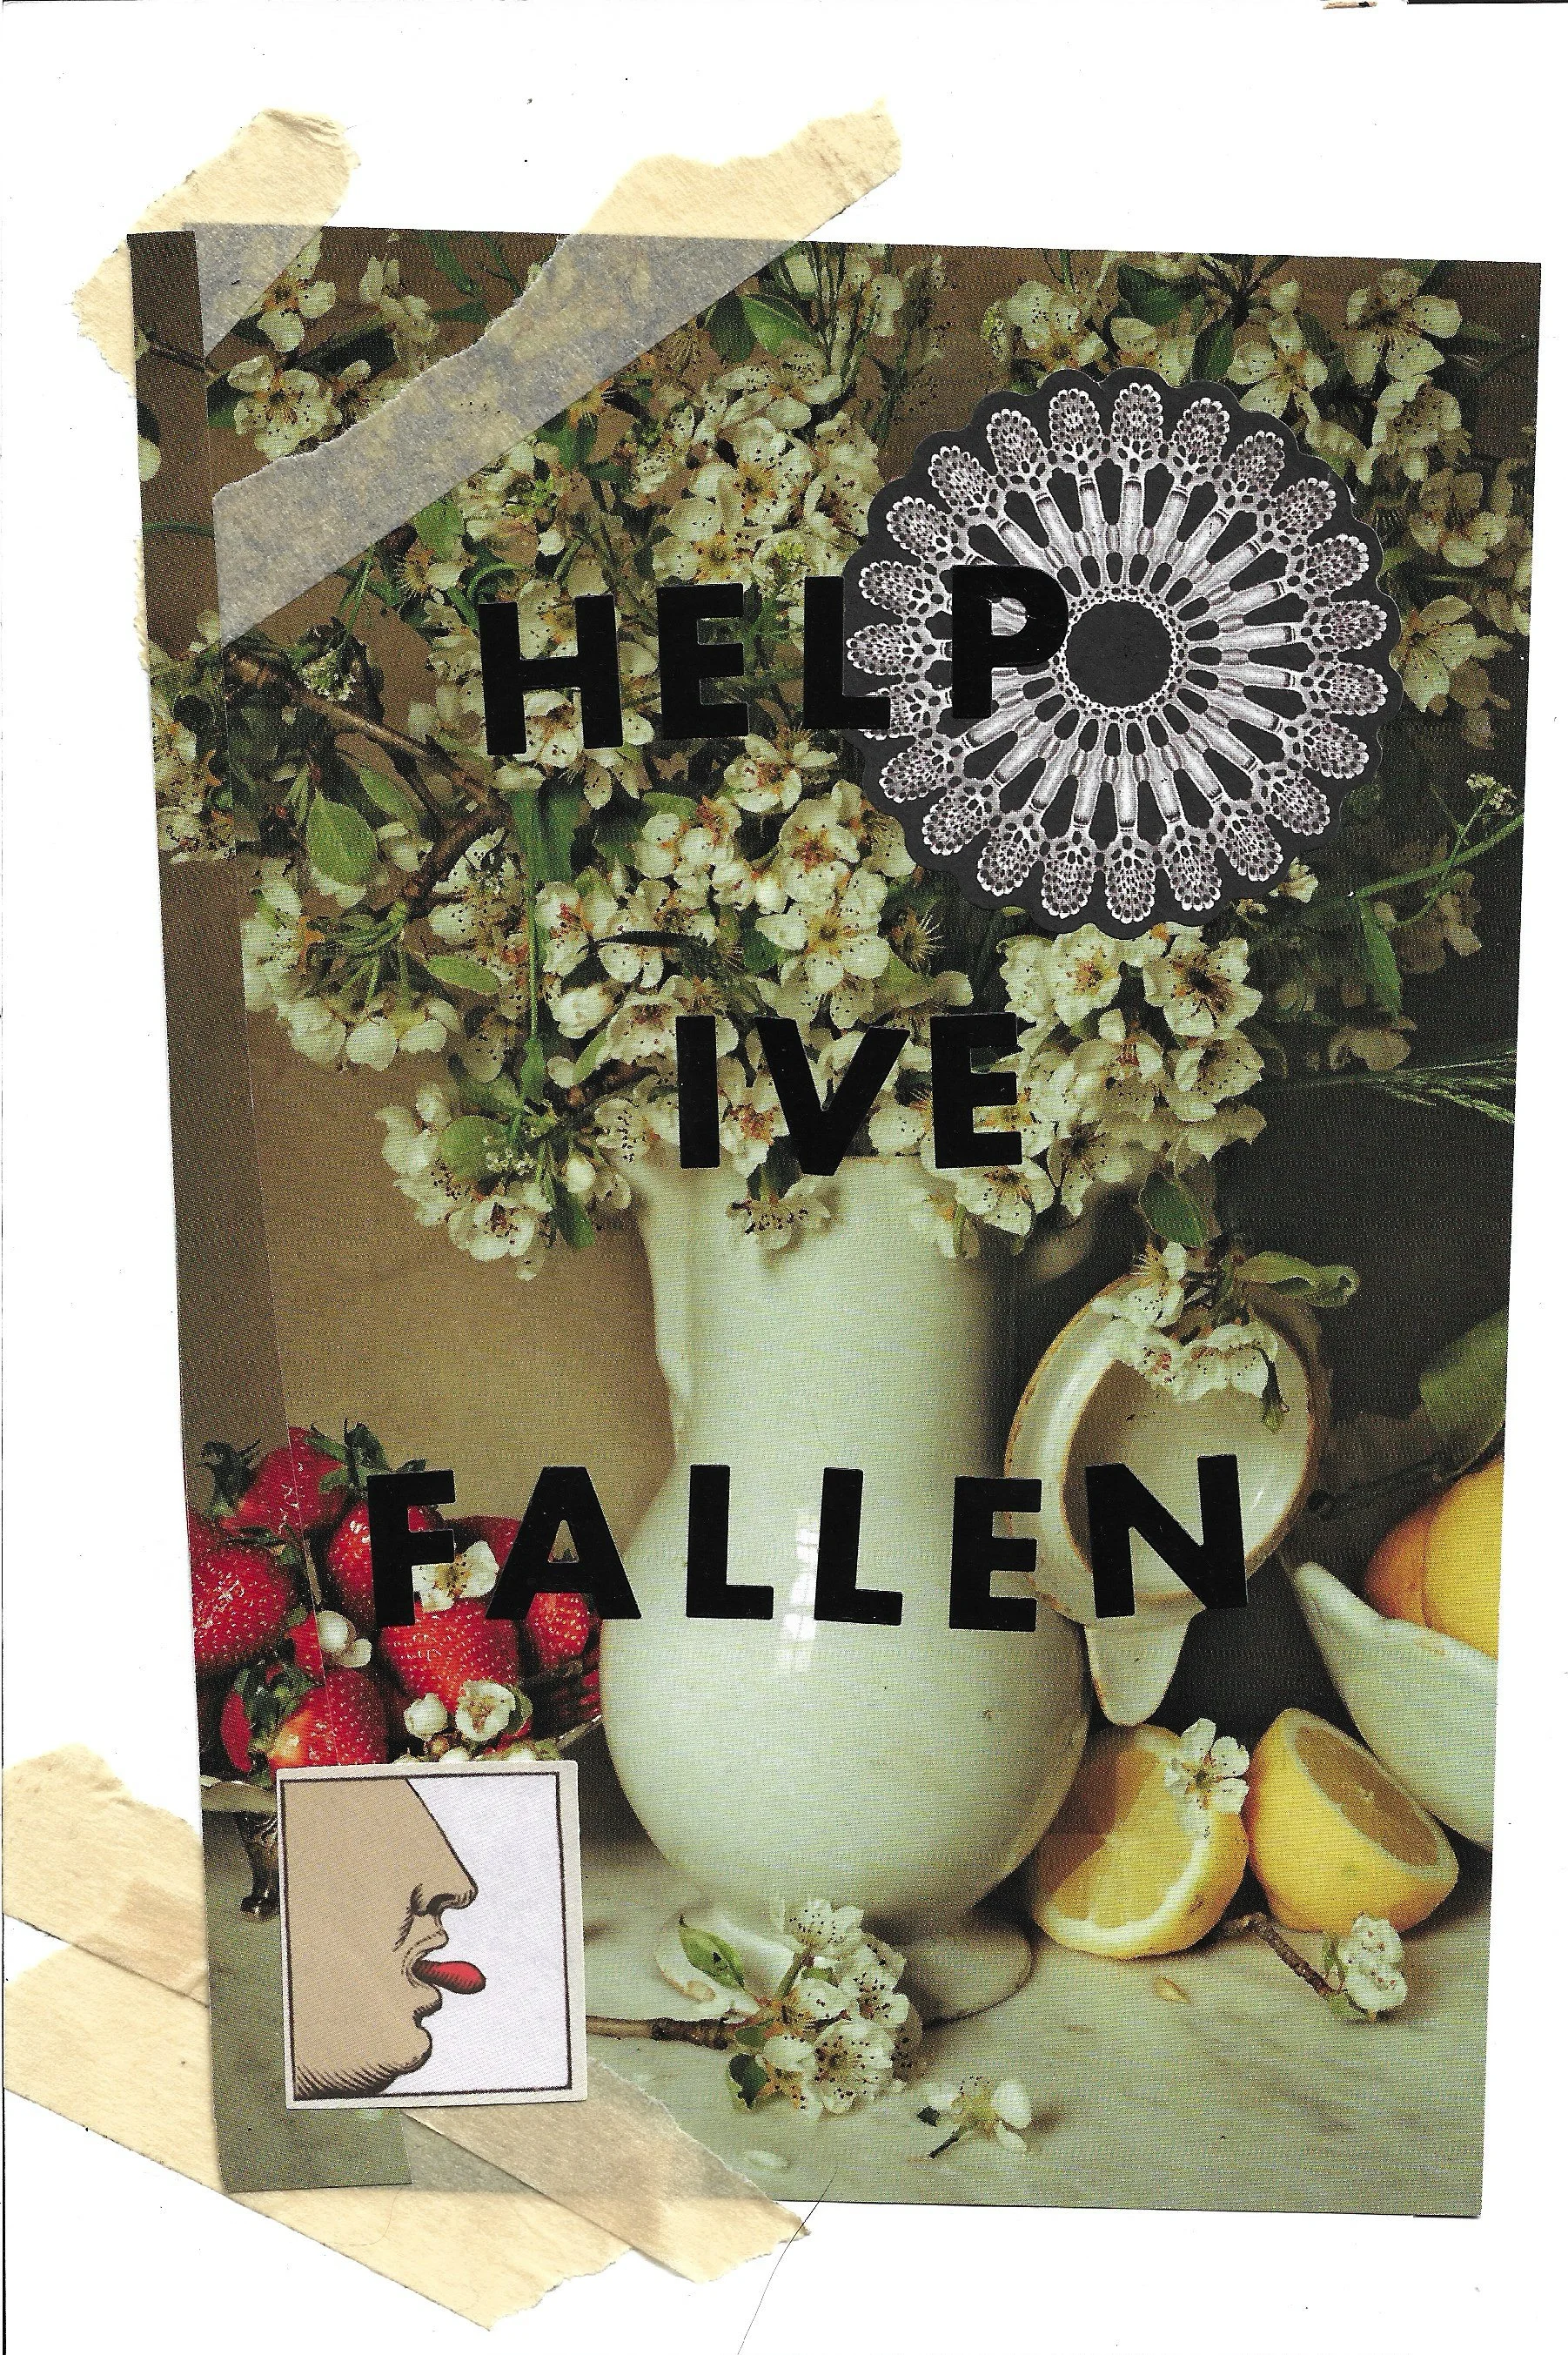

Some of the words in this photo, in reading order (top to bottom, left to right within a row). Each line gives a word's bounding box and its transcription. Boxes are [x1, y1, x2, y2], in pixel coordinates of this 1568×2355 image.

[479, 565, 1069, 755] HELP
[675, 1012, 1023, 1176] IVE
[367, 1454, 1248, 1632] FALLEN
